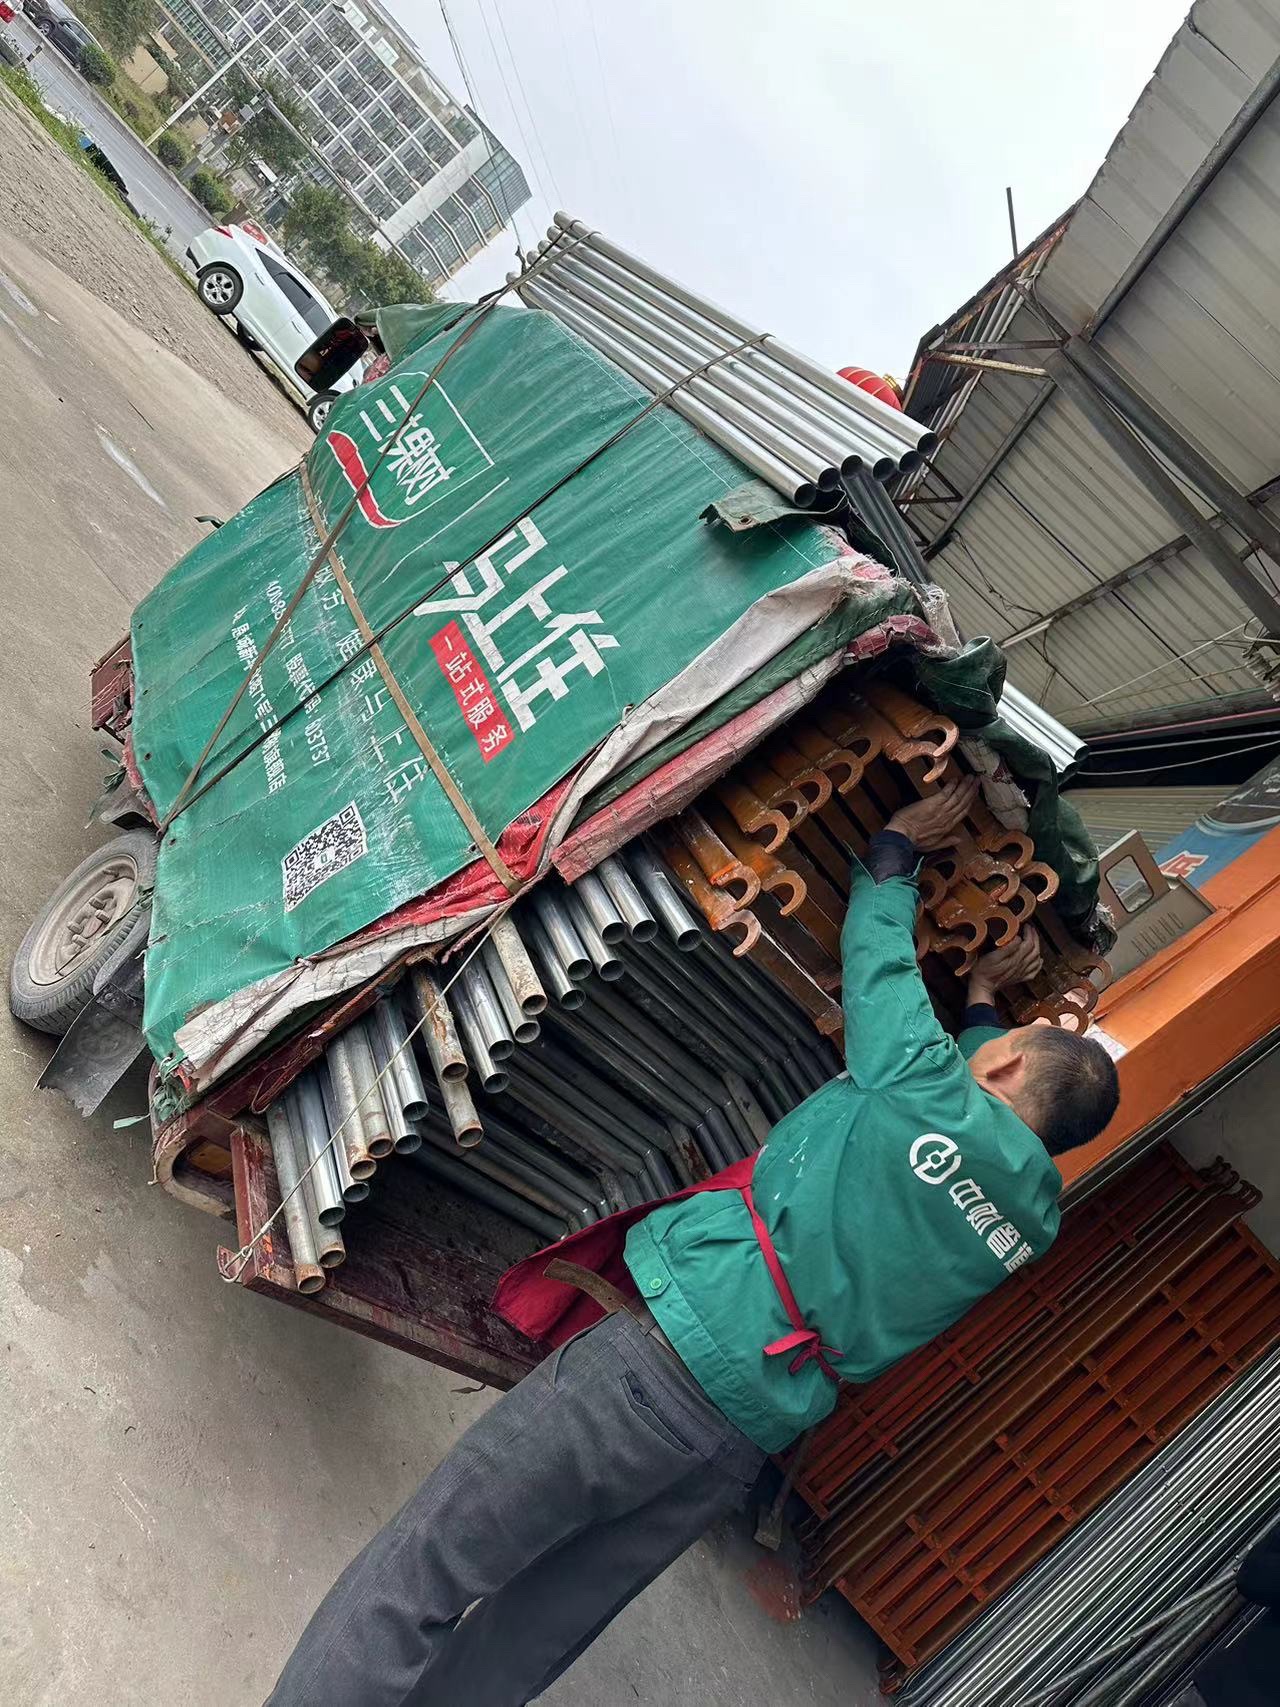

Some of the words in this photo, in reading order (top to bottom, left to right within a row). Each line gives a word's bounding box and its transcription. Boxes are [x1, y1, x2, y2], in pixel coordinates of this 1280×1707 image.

[359, 384, 456, 505] 三棵树
[413, 516, 621, 733] 马上住
[442, 635, 511, 754] 一站式服务
